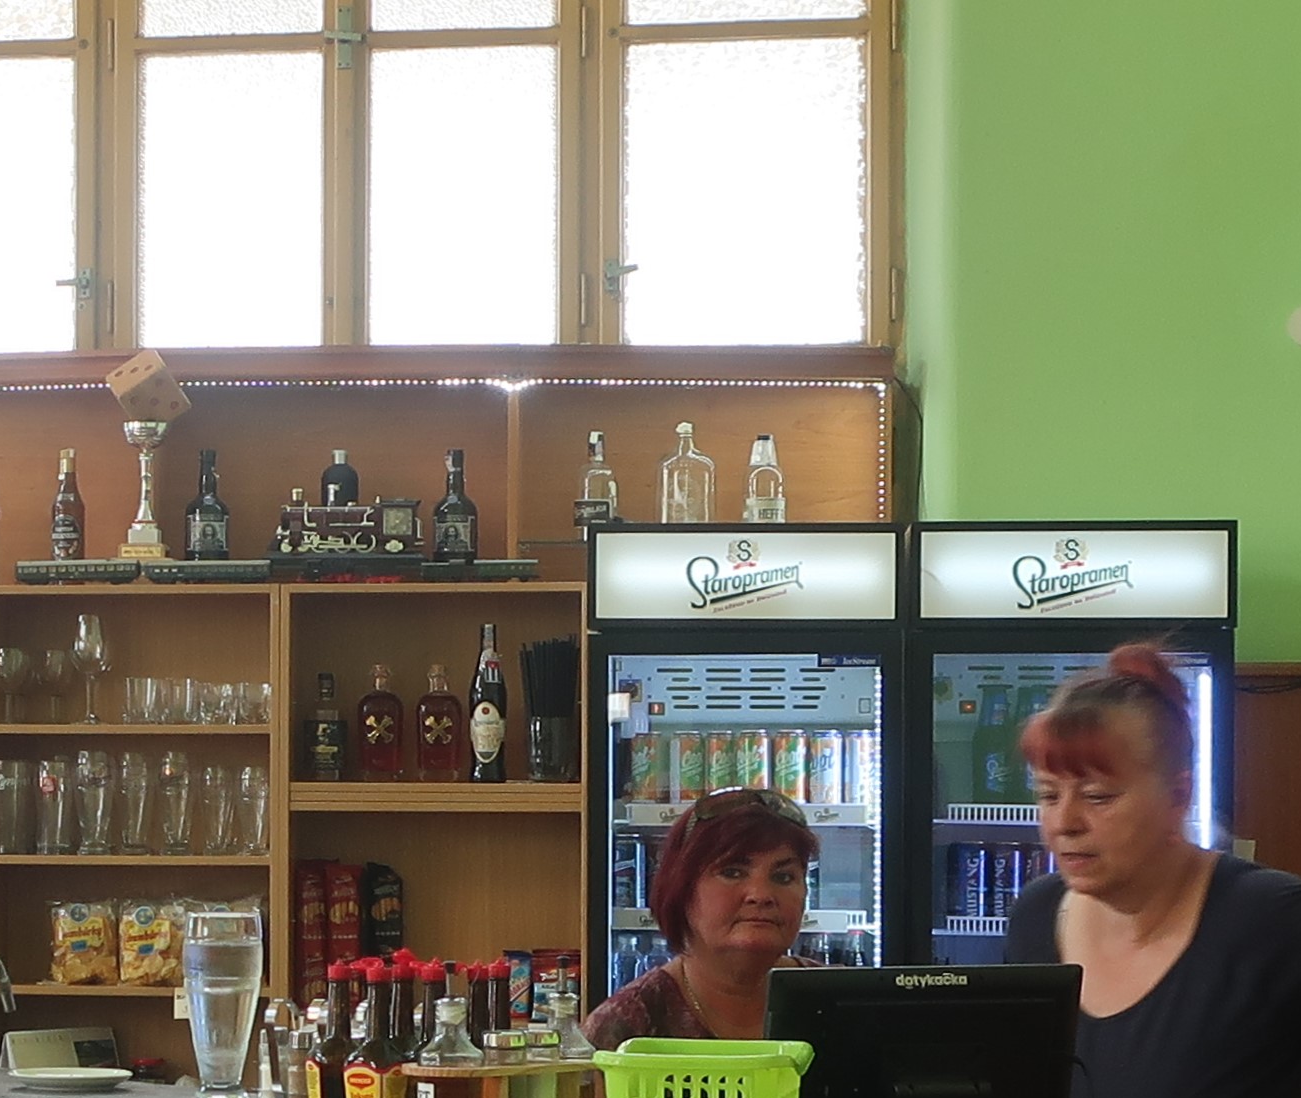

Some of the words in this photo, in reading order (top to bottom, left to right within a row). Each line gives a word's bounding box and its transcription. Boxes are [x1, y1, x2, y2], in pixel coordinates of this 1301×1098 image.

[686, 556, 804, 609] Staropramen
[1013, 556, 1134, 609] Staropramen
[895, 972, 968, 990] dotykačka
